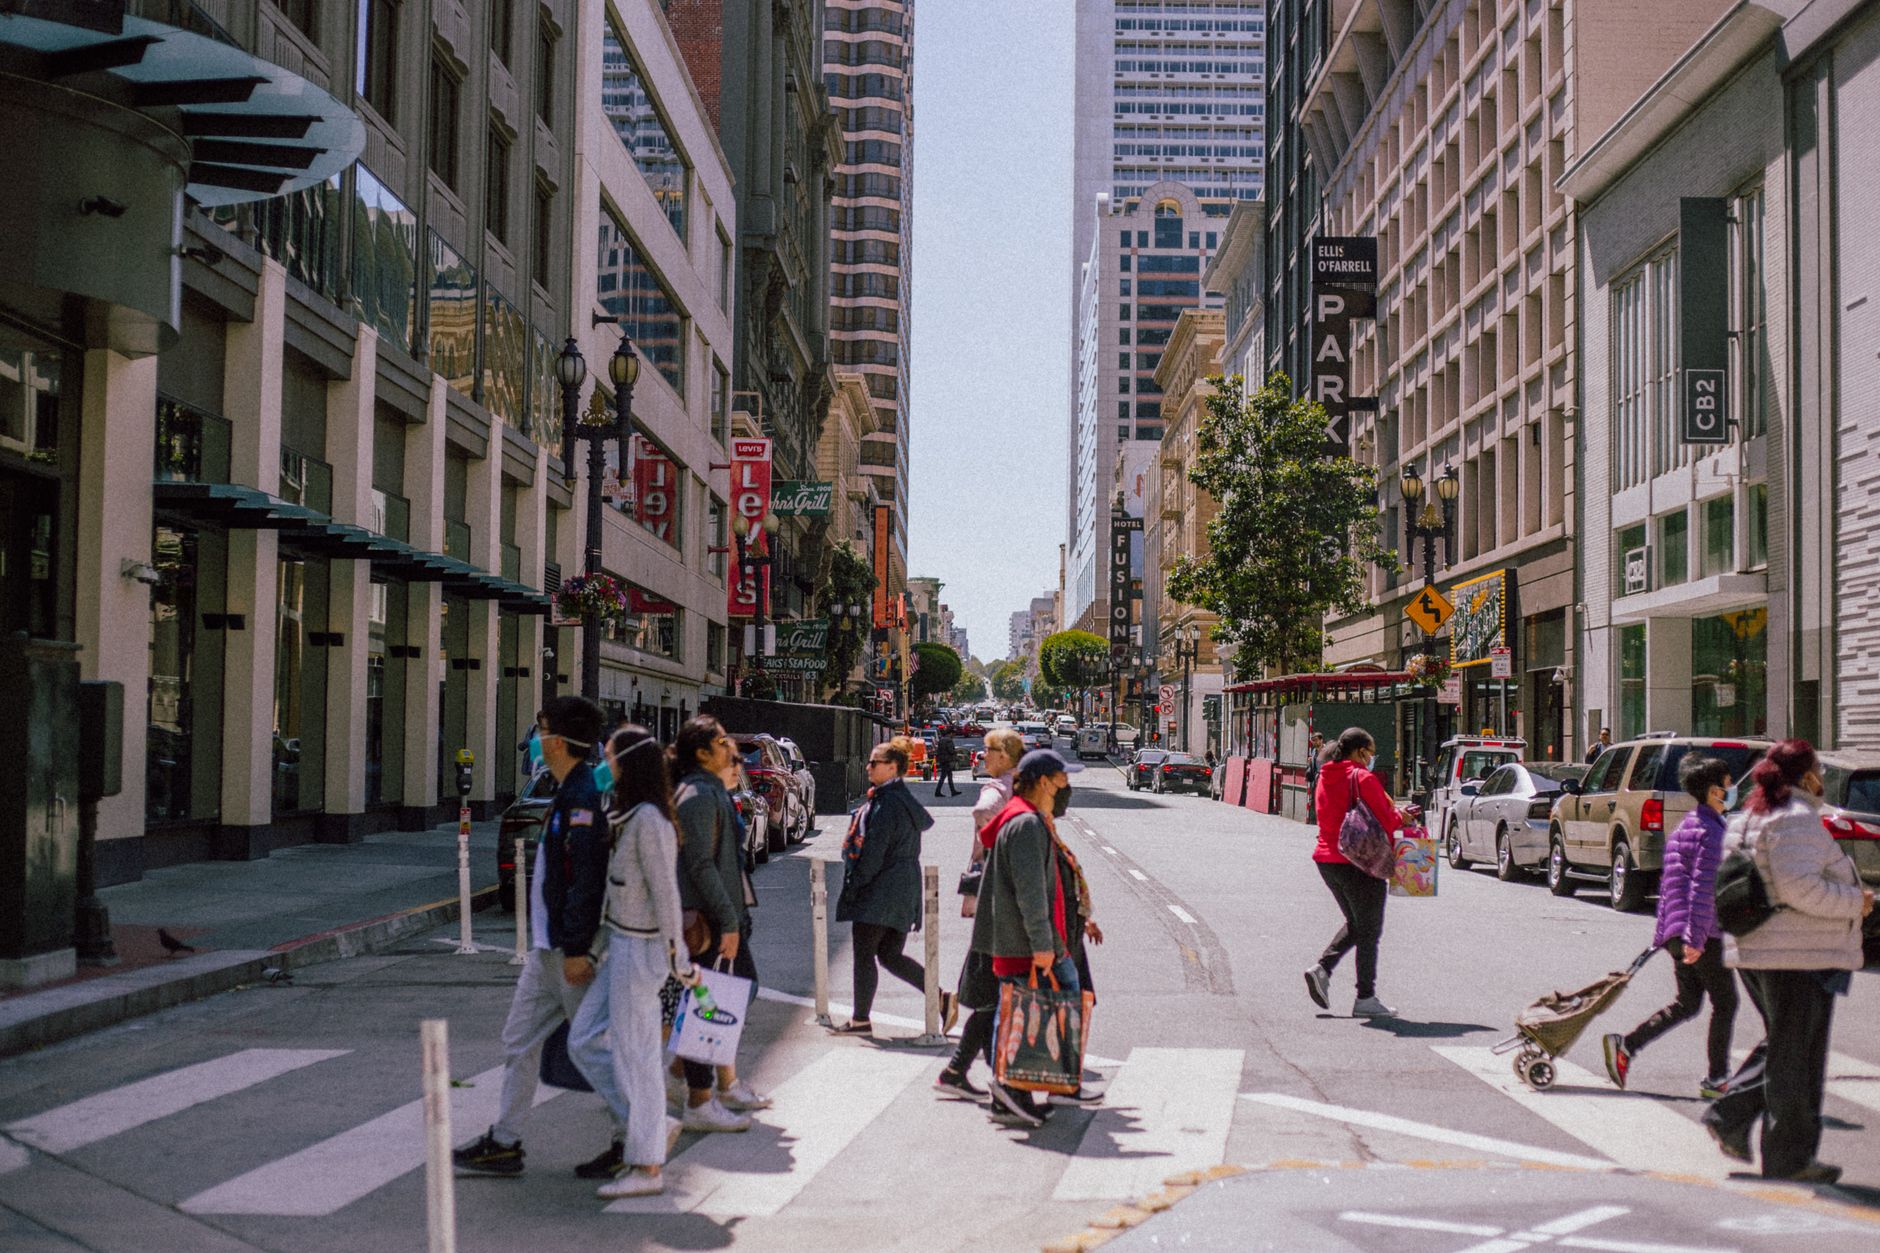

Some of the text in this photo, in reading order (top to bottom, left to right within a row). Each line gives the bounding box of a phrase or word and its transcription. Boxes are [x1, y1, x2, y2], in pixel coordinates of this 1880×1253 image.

[1318, 246, 1345, 257] ELLIS
[1317, 260, 1372, 272] O'FARRELL
[1695, 379, 1716, 431] CB2
[794, 492, 828, 515] Grill
[1113, 520, 1142, 528] HOTEL
[1113, 535, 1127, 637] FUSION
[790, 629, 824, 653] Grill
